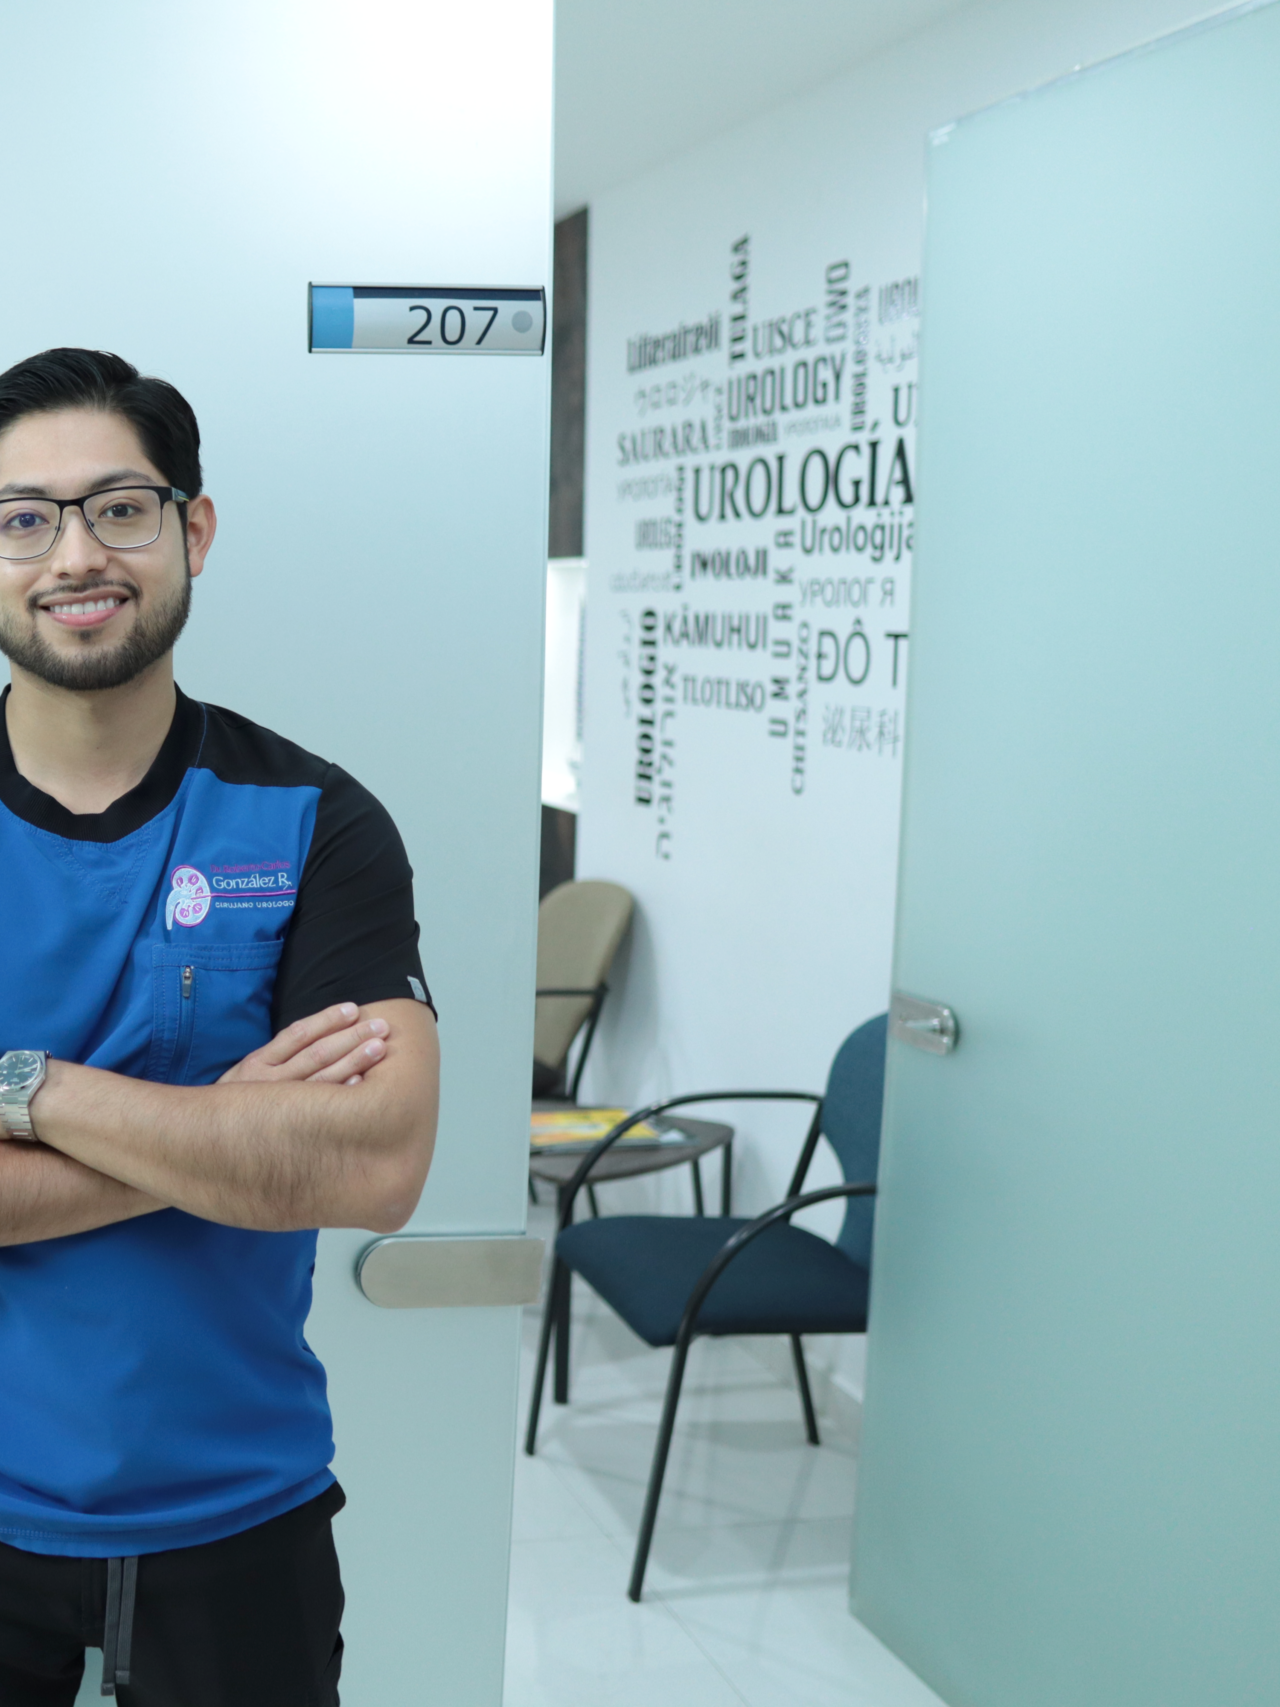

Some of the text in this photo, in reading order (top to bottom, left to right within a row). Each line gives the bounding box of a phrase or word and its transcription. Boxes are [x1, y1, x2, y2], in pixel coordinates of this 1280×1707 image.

[407, 305, 499, 345] 207
[751, 306, 818, 359] UISCE
[726, 350, 846, 423] UROLOGY
[616, 419, 710, 466] SAURARA
[692, 420, 914, 522] UROLOGÍA
[816, 617, 871, 686] ĐÔ
[635, 605, 658, 806] UROLOGIO
[681, 674, 766, 714] TLOTLISO
[791, 620, 811, 796] CHITSANZO
[821, 704, 901, 758] 泌尿科
[212, 873, 276, 889] González
[223, 863, 260, 873] Roberto
[261, 860, 291, 870] Carlos
[215, 899, 295, 909] CIRUJANO URÓLOGO
